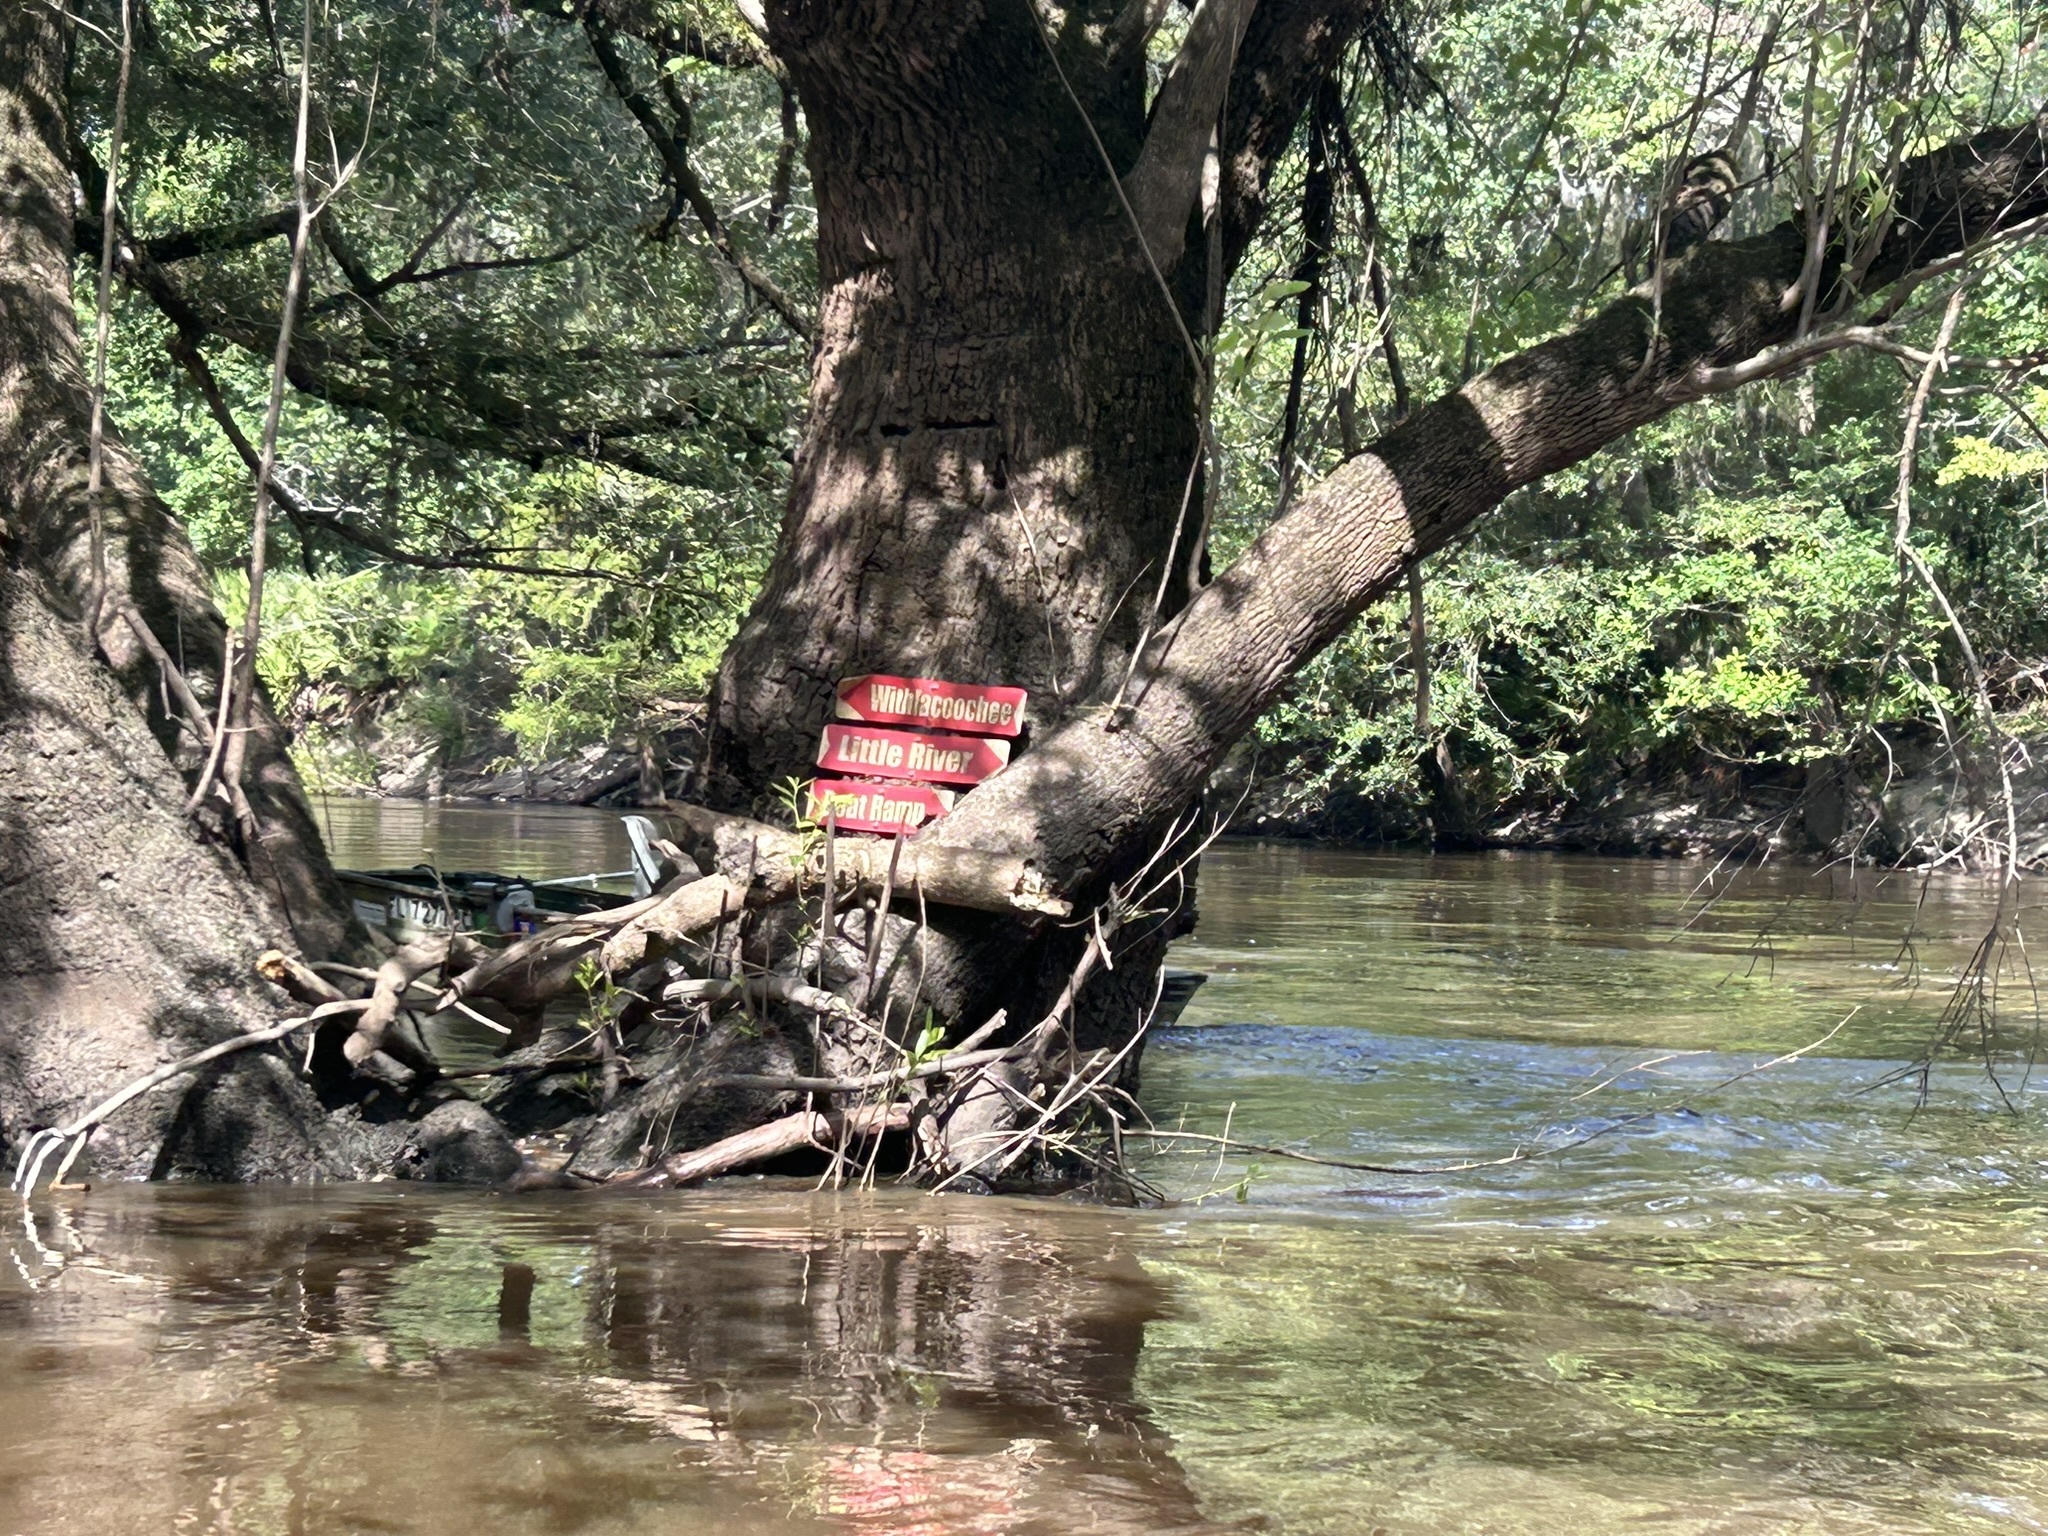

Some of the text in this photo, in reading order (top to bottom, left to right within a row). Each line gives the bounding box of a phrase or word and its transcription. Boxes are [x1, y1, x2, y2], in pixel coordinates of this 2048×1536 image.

[871, 685, 1014, 725] Withlacoochee
[837, 735, 974, 774] Little River
[869, 794, 926, 827] Ramp
